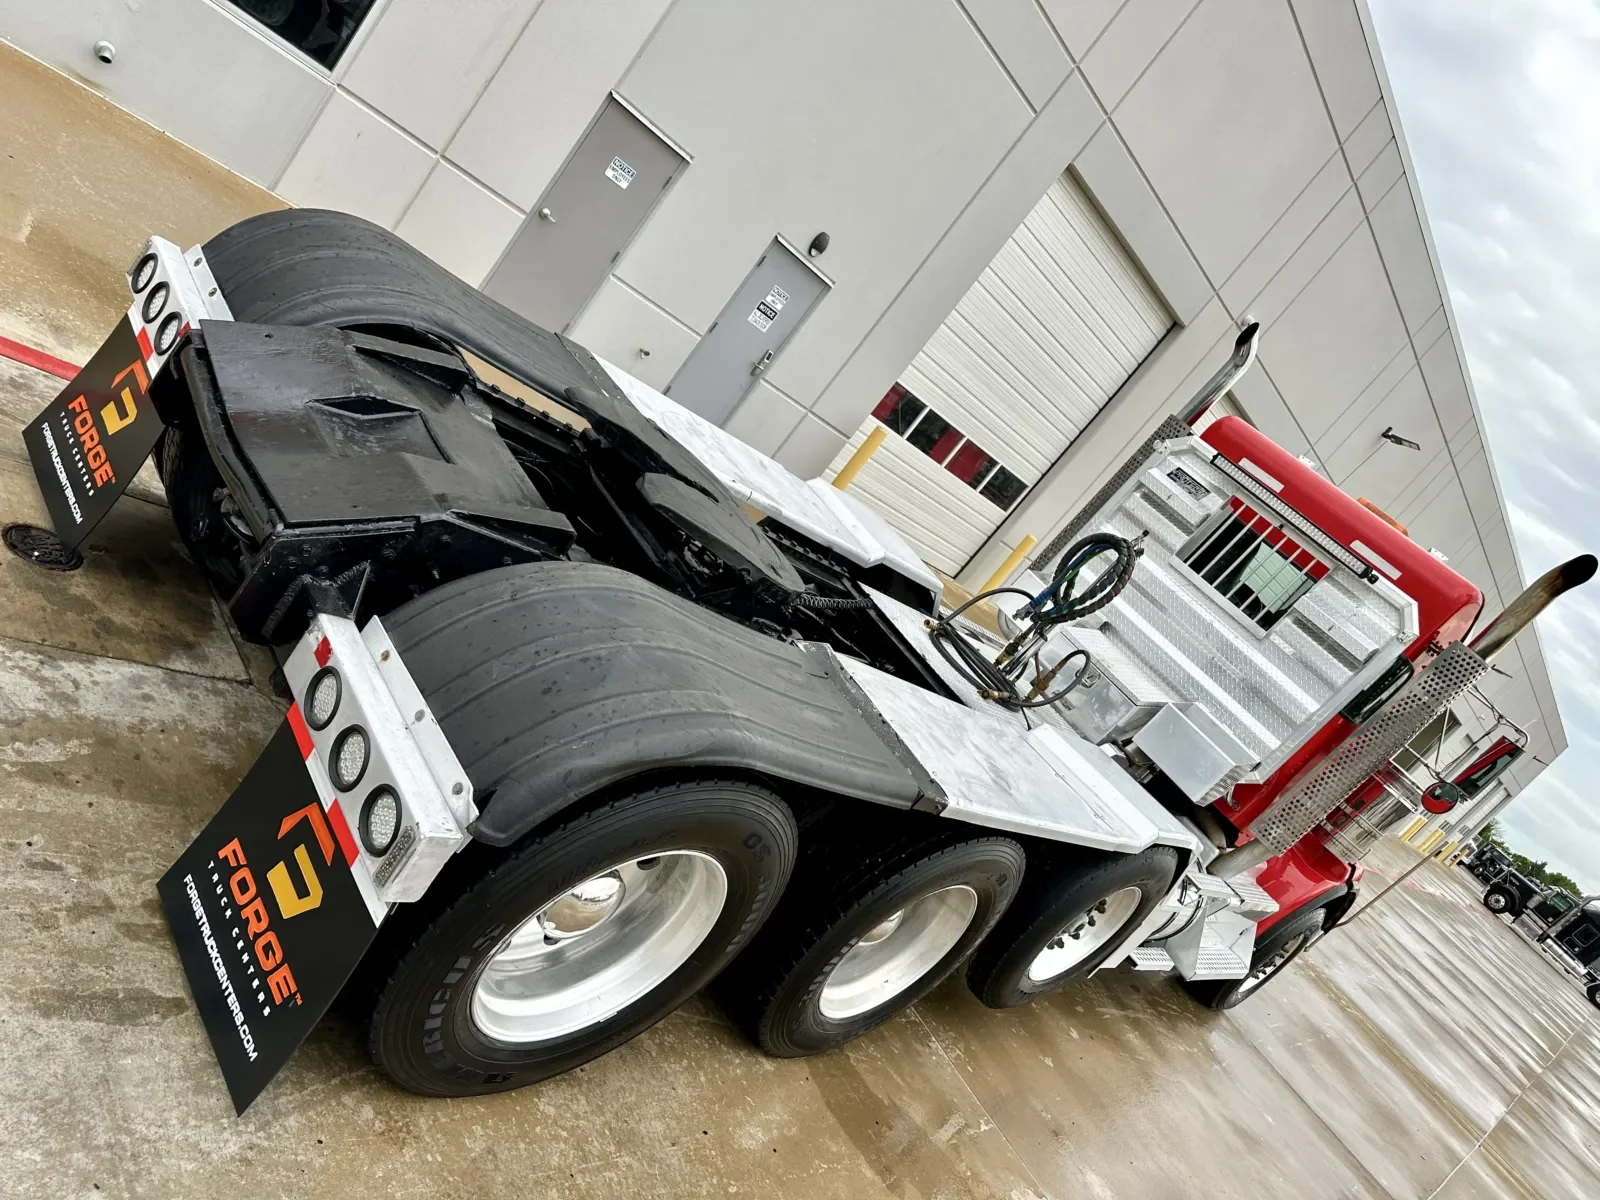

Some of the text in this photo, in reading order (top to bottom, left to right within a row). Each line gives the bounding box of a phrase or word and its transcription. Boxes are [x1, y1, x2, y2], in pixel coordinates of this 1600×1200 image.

[612, 158, 634, 179] NOTICE
[758, 303, 776, 320] NOTICE
[41, 421, 84, 525] FORGETRUCKCENTERS.COM
[60, 411, 95, 497] TRUCK CENTERS
[68, 394, 114, 488] FORGE
[183, 873, 259, 1063] FORGETRUCKCENTERS.COM
[207, 860, 271, 1018] TRUCK CENTERS
[217, 837, 299, 1006] FORGE
